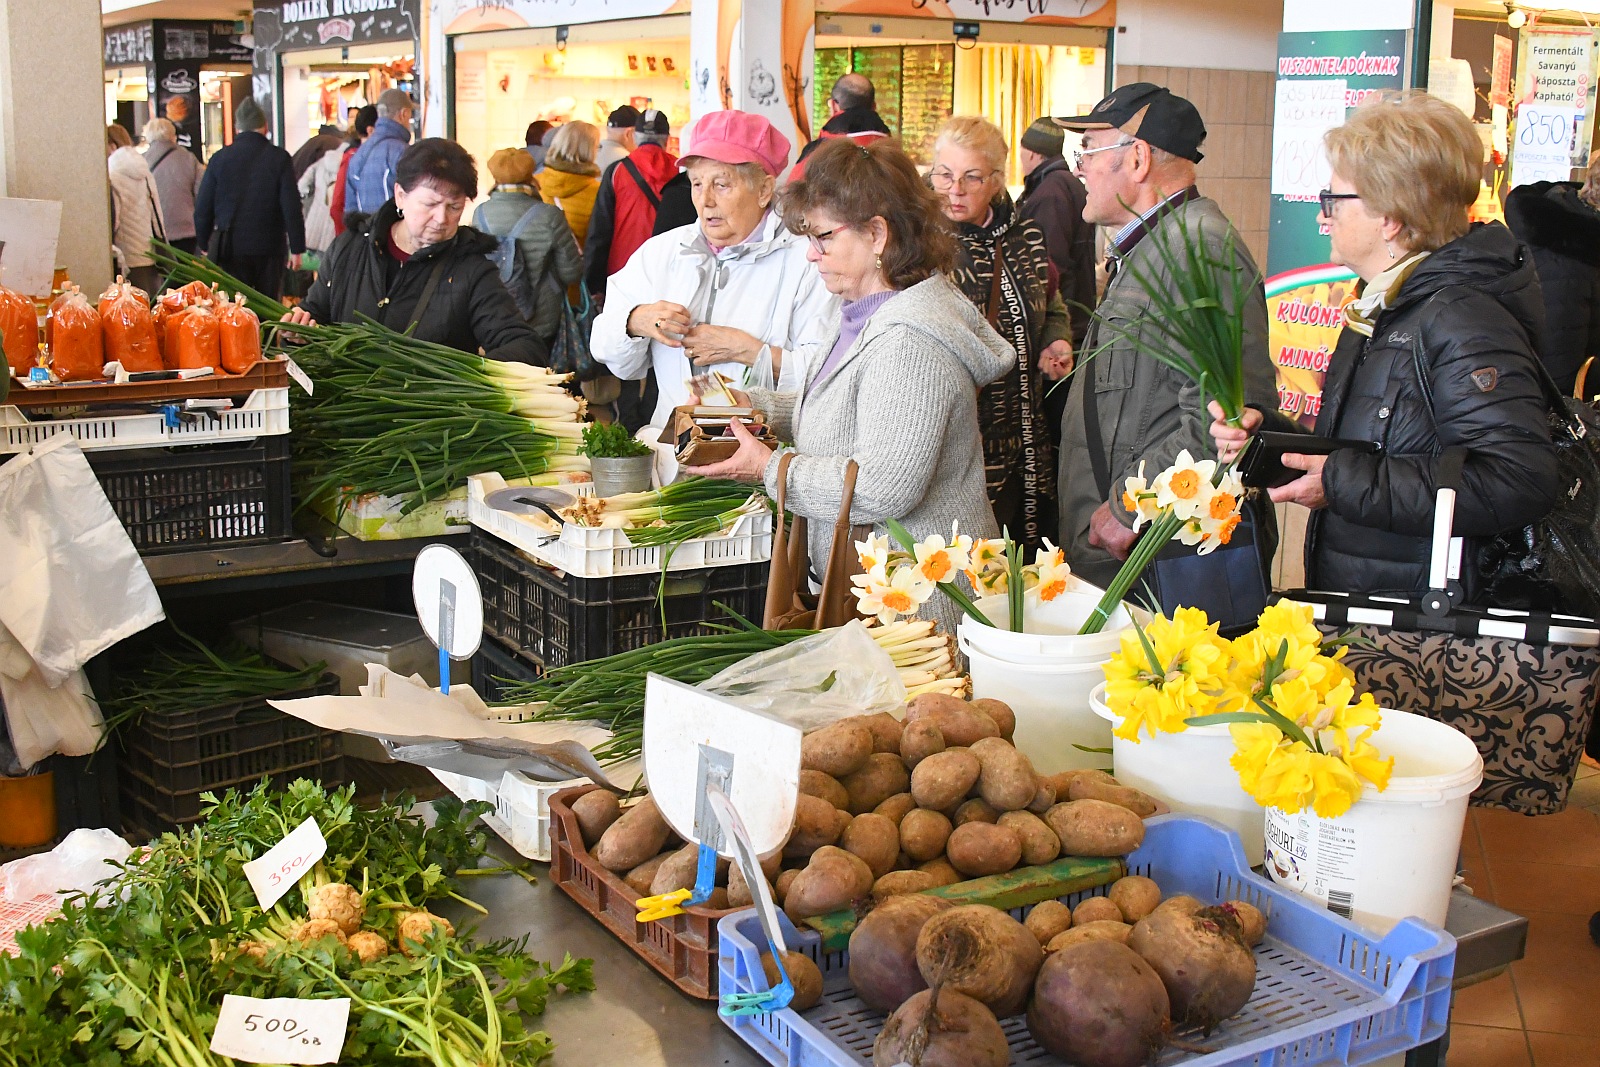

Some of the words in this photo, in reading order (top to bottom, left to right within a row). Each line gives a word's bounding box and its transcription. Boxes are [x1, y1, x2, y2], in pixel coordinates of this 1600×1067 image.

[1279, 50, 1400, 76] VISZONTELADÓKNAK
[1533, 46, 1584, 56] Fermentált
[1538, 61, 1576, 73] Savanyú
[1536, 75, 1576, 87] káposzta
[1533, 91, 1574, 102] Kapható!
[1521, 110, 1566, 145] 850
[1277, 298, 1346, 328] KÜLÖNF
[1014, 324, 1028, 371] REMIND
[1020, 373, 1030, 399] AND
[1021, 402, 1034, 445] WHERE
[1024, 447, 1036, 472] AND
[1024, 473, 1037, 497] ARE
[1024, 498, 1037, 519] YOU
